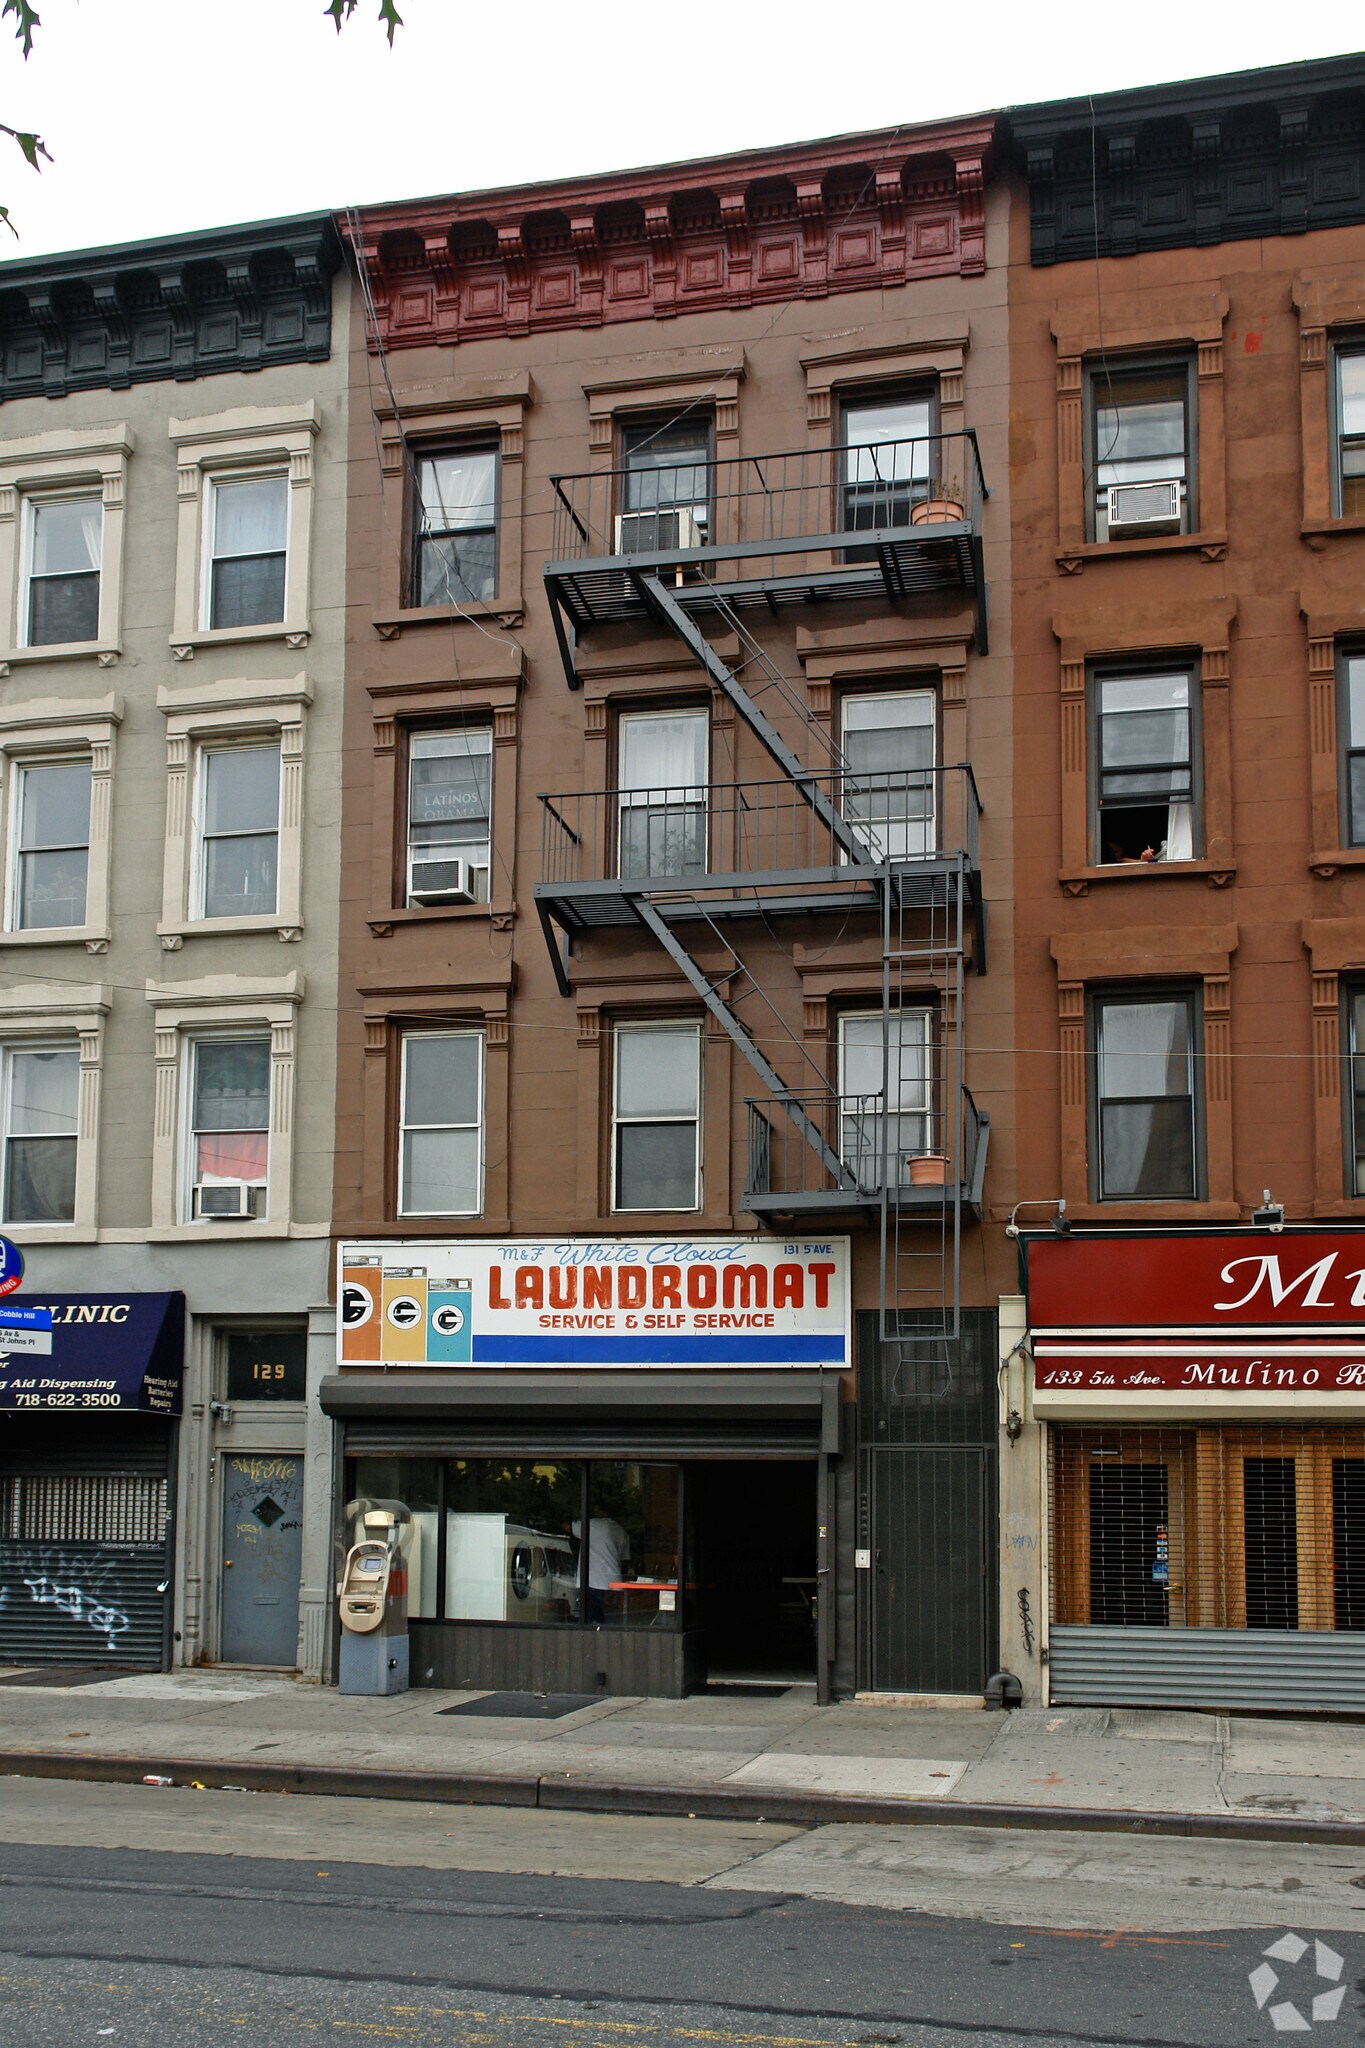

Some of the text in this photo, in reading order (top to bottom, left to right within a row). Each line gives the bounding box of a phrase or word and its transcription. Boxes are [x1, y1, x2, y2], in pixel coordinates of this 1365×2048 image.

[425, 792, 479, 806] LATINOS
[554, 1243, 640, 1265] White
[646, 1242, 747, 1265] Cloud
[784, 1244, 799, 1255] 131
[489, 1263, 836, 1309] LAUNDROMAT
[0, 1310, 36, 1320] Cobble Hill
[538, 1313, 775, 1329] SERVICE & SELF SERVICE
[6, 1337, 27, 1345] Johns
[252, 1363, 286, 1380] 129
[1043, 1370, 1083, 1384] 133
[1089, 1370, 1116, 1385] 5th
[1123, 1370, 1166, 1385] Ave.
[1181, 1361, 1320, 1385] Mulino
[10, 1379, 35, 1389] Aid
[38, 1378, 117, 1390] Dispensing
[143, 1375, 178, 1388] Hearing Aid
[147, 1386, 174, 1398] Batteries
[15, 1393, 121, 1406] 718-622-3500
[150, 1397, 172, 1408] Repairs
